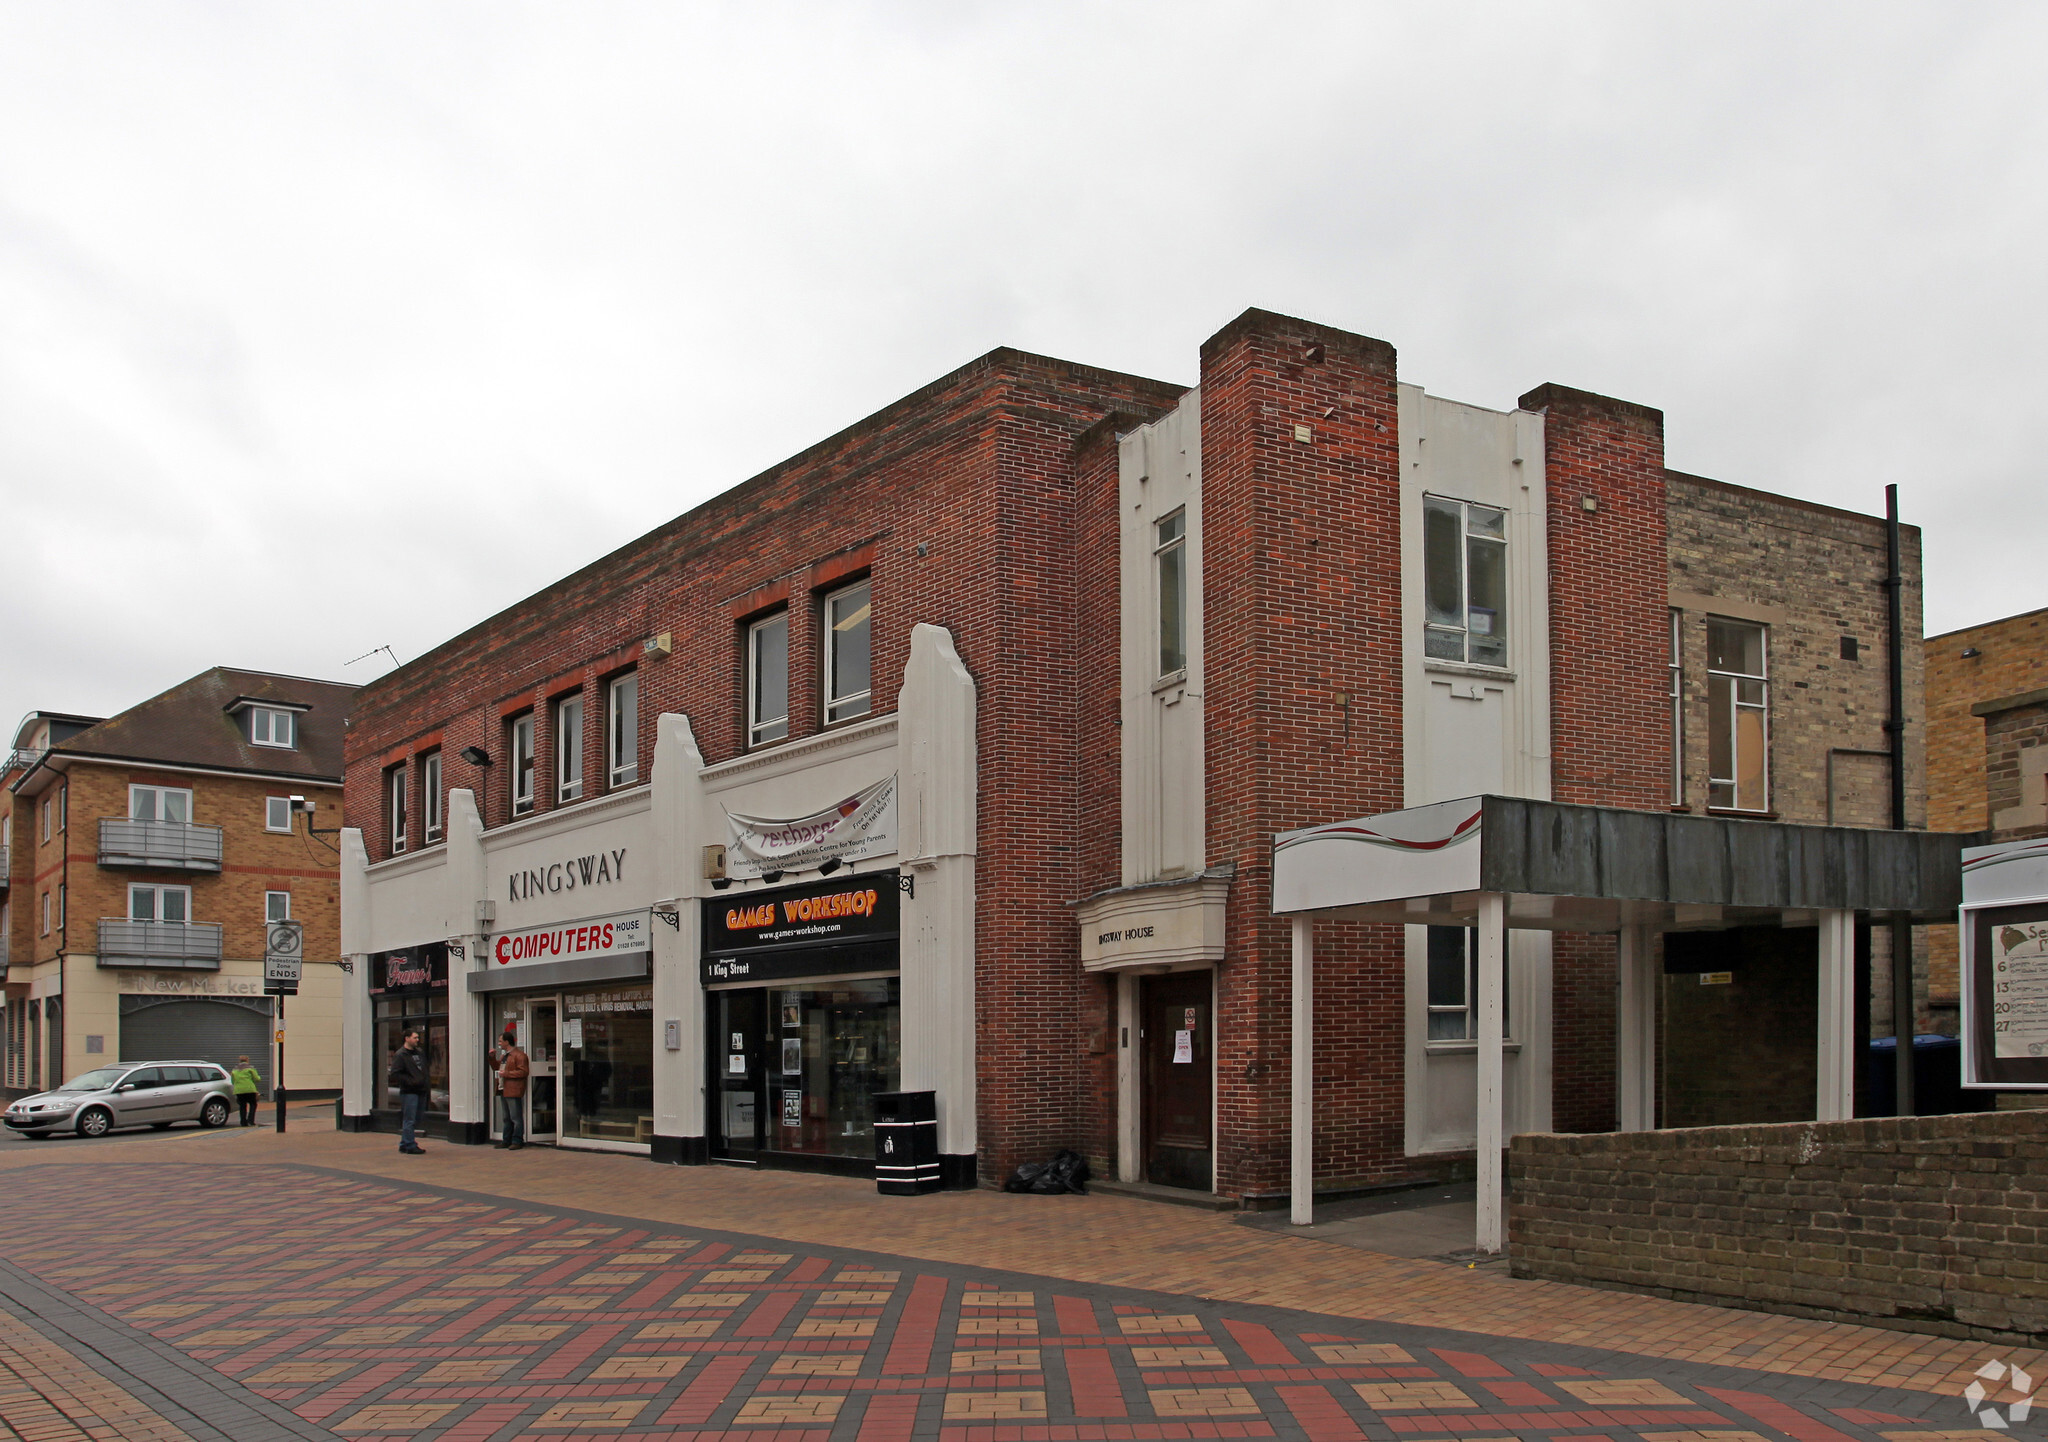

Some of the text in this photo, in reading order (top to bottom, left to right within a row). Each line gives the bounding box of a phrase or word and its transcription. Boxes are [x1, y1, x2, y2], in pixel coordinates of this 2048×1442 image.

[881, 787, 893, 800] Cake
[861, 822, 870, 830] On
[869, 813, 877, 822] 1st
[876, 802, 887, 814] Visit
[777, 852, 797, 861] Support
[848, 839, 866, 847] Young
[866, 834, 886, 842] Parents
[844, 848, 860, 856] under
[509, 848, 626, 902] KINGSWAY
[726, 889, 878, 930] GAMES WORKSHOP
[759, 924, 841, 940] www.games-workshop.com
[1125, 926, 1154, 940] HOUSE
[495, 920, 639, 965] COMPUTERS HOUSE
[270, 970, 297, 978] ENDS
[708, 962, 749, 978] 1 King Street
[1998, 962, 2007, 972] 6
[136, 975, 257, 994] New Maket
[1996, 982, 2009, 993] 13
[601, 1002, 613, 1011] VIRUS
[1995, 1002, 2010, 1014] 20
[1995, 1021, 2009, 1033] 27
